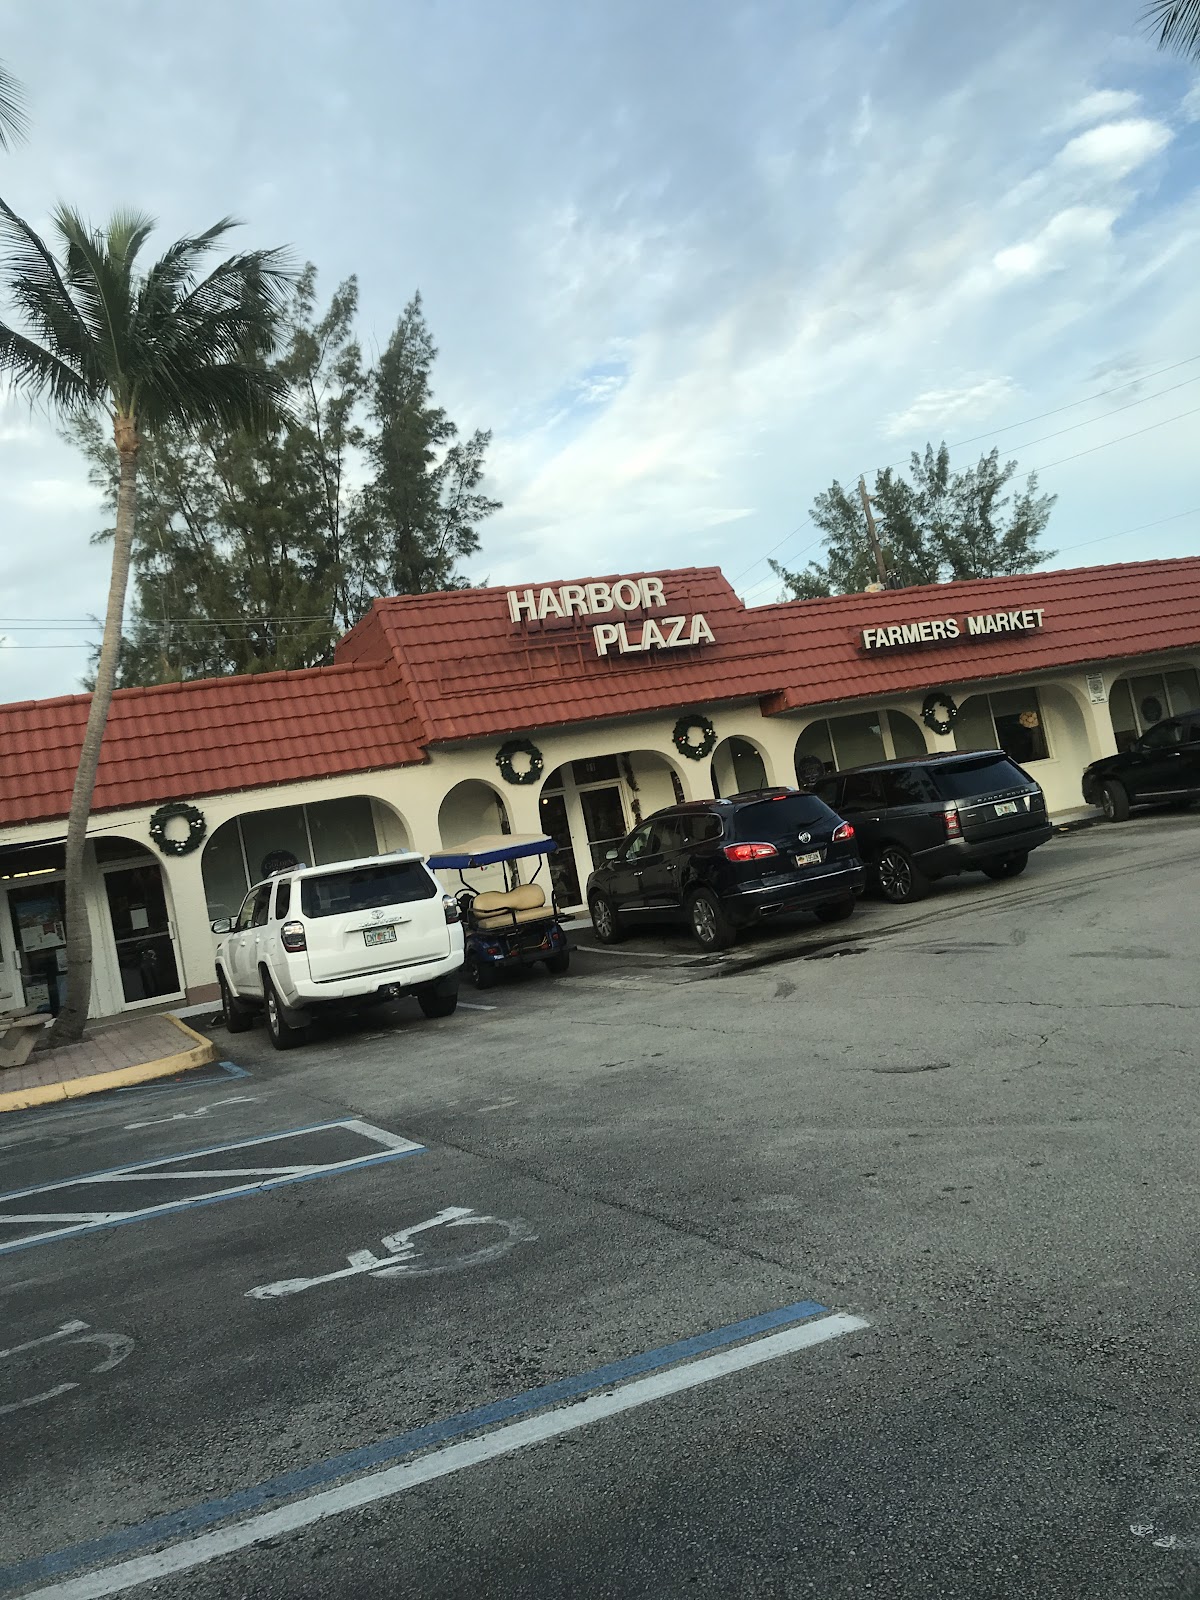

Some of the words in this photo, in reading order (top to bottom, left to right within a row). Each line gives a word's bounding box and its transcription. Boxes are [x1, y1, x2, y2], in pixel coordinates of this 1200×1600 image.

[506, 577, 667, 623] HARBOR
[592, 614, 716, 657] PLAZA
[862, 618, 960, 649] FARMERS
[967, 608, 1045, 636] MARKET
